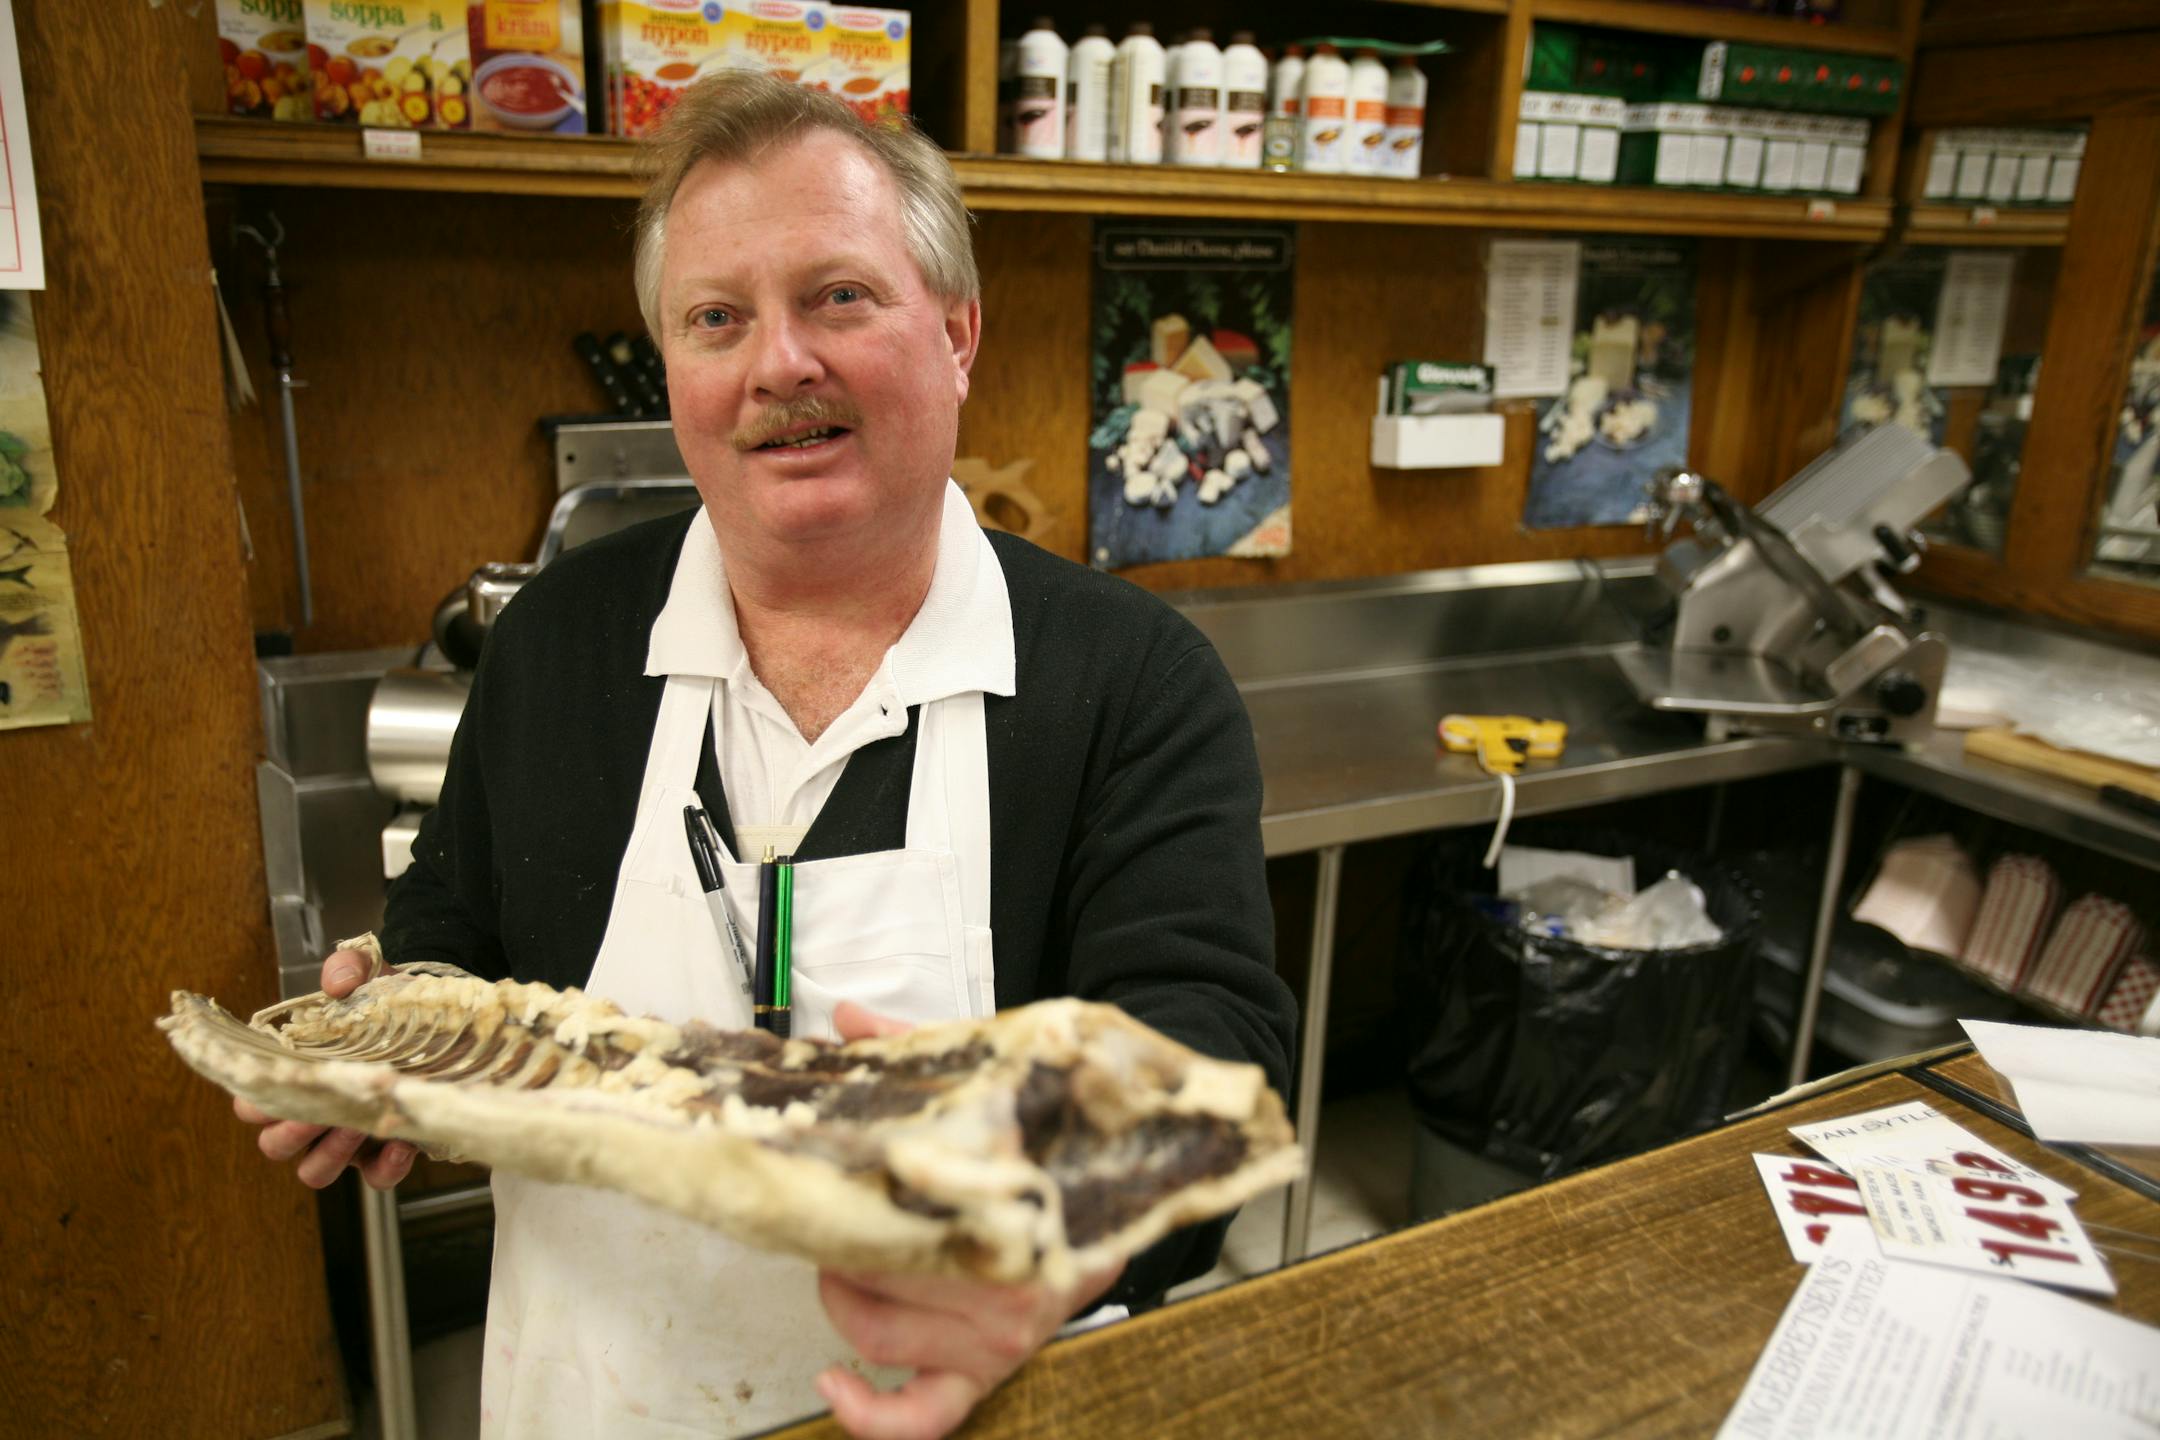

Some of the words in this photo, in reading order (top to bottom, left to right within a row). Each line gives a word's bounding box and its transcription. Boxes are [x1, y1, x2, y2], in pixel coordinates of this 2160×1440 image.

[240, 0, 302, 21] sopp
[329, 2, 405, 28] soppa
[1842, 1257, 1890, 1329] CENTER
